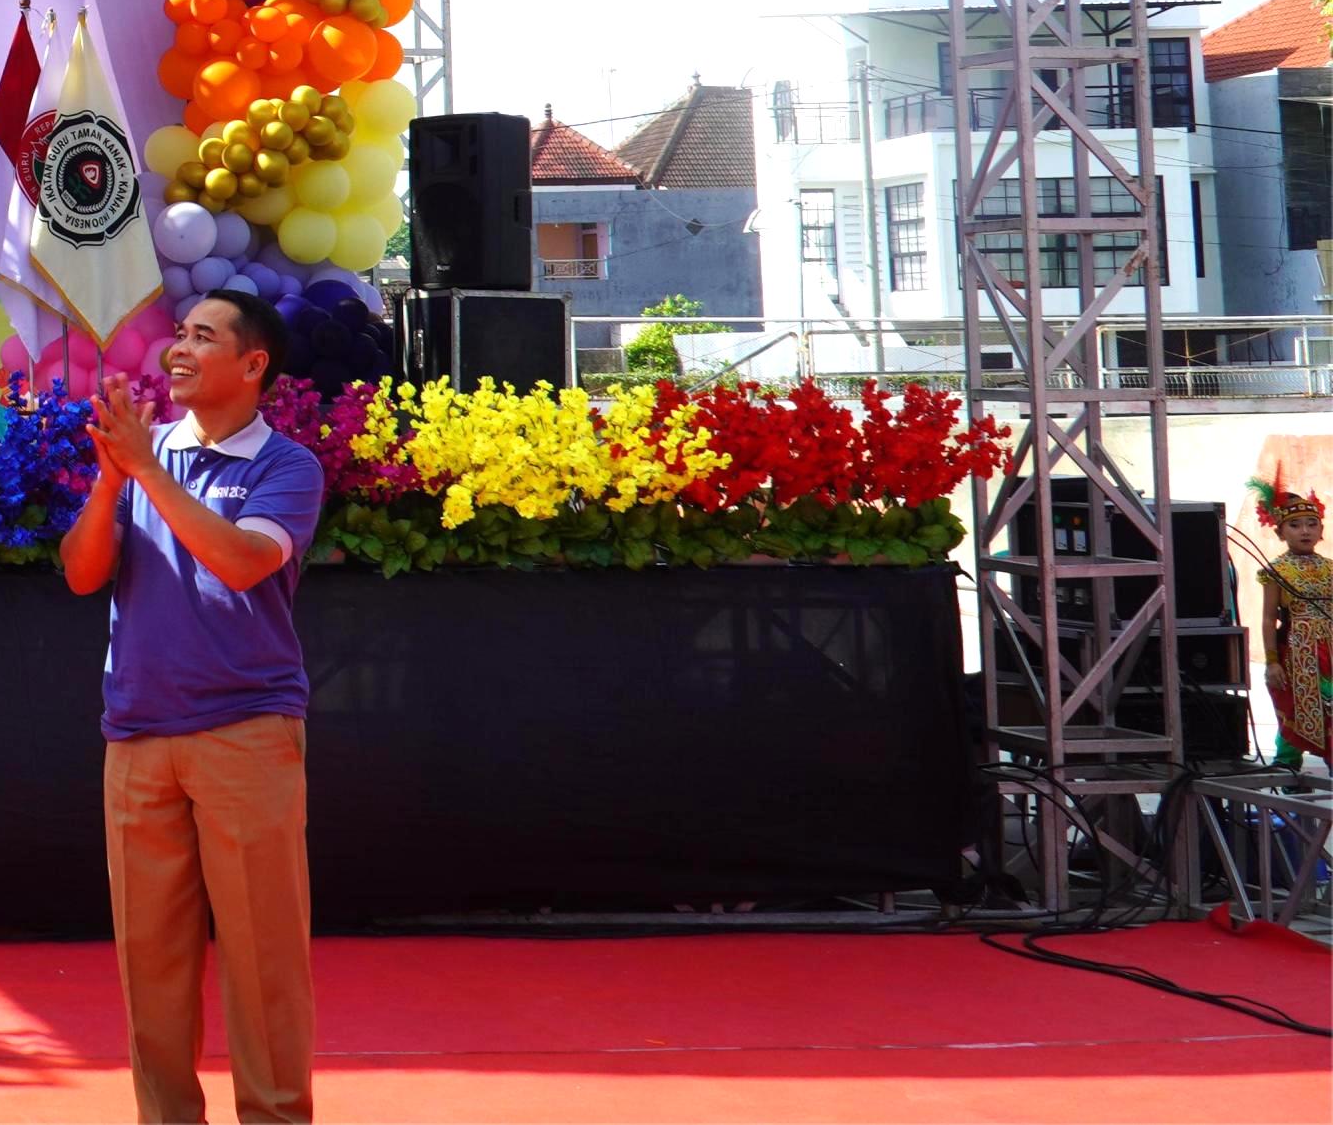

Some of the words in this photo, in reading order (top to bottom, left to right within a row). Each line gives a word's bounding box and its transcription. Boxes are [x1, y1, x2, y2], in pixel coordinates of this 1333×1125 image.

[49, 134, 70, 162] GURU
[70, 128, 102, 141] TAMAN
[102, 137, 127, 170] KANAK
[43, 164, 56, 203] IKATAN
[109, 180, 129, 214] KANAK
[65, 211, 110, 230] INDONESIA
